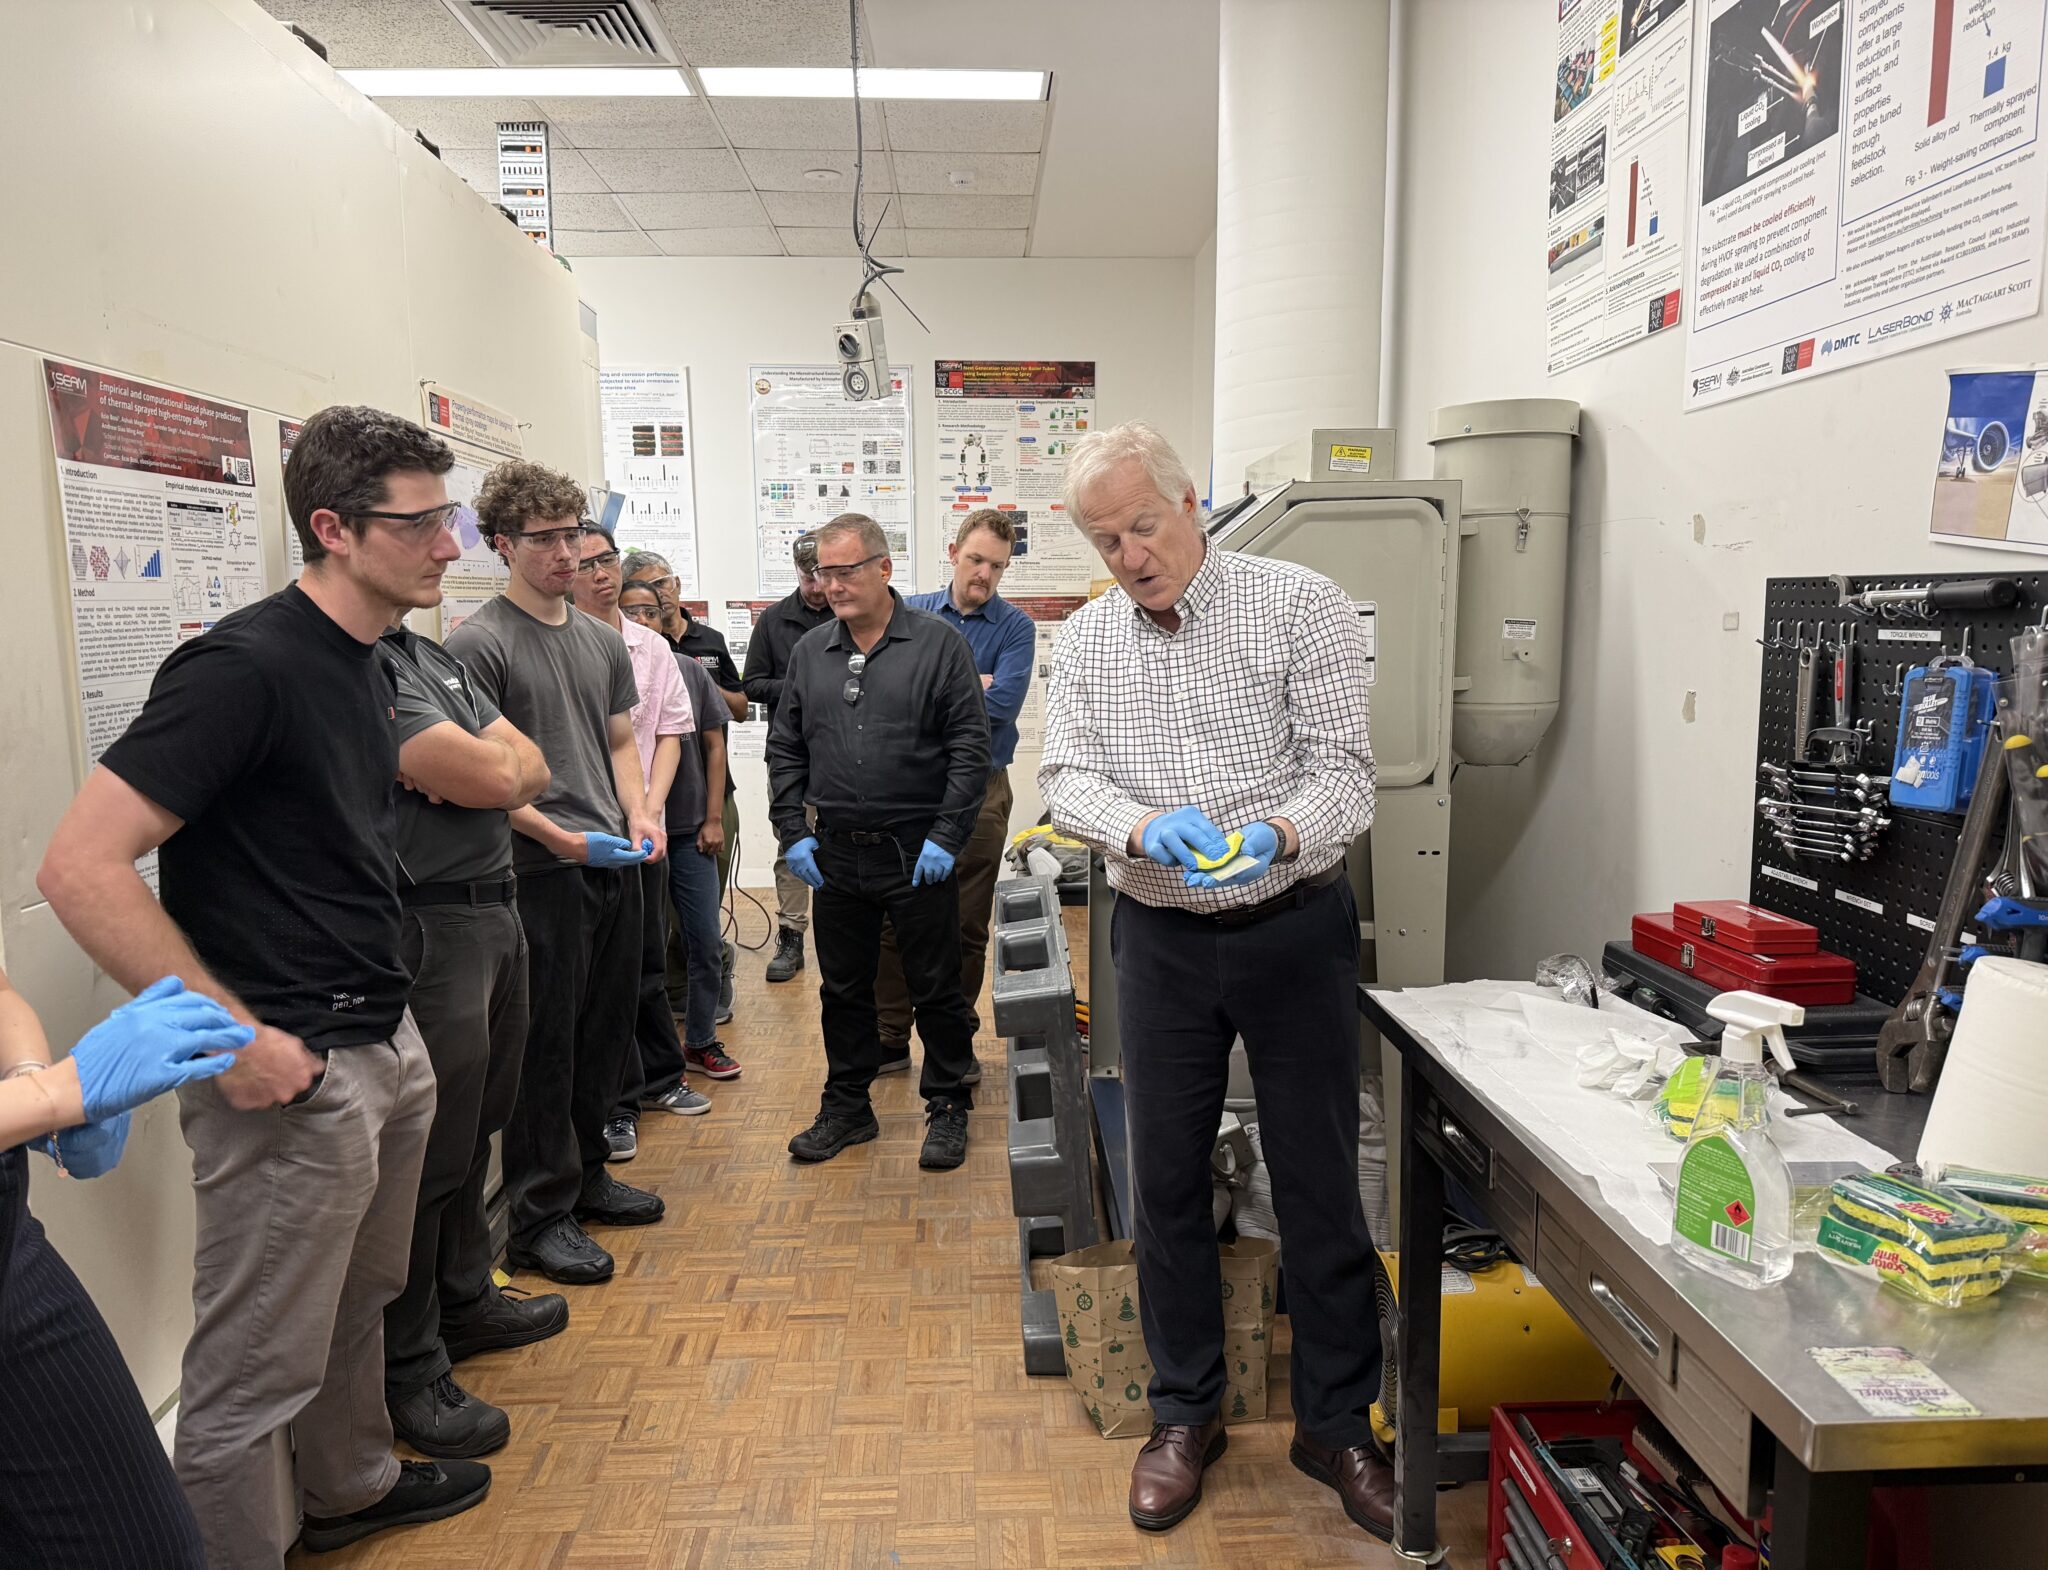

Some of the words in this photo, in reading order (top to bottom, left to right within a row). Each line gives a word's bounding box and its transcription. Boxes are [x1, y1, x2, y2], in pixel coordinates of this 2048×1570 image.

[1811, 7, 1838, 31] Workpiece
[1858, 3, 1905, 38] components
[1859, 0, 1889, 22] sprayed
[1963, 7, 1996, 32] reduction
[1857, 38, 1874, 55] offer
[1875, 35, 1881, 44] a
[1882, 20, 1904, 43] large
[1856, 47, 1891, 72] reduction
[1892, 39, 1900, 53] in
[1987, 48, 1999, 60] 1.4
[2002, 41, 2012, 53] kg
[1855, 67, 1882, 89] weight,
[1883, 56, 1899, 73] and
[1854, 83, 1882, 105] surface
[1969, 100, 2004, 125] Thermally
[2005, 83, 2037, 106] sprayed
[1740, 107, 1754, 122] Liquid
[1852, 123, 1867, 138] can
[1868, 115, 1878, 129] be
[1879, 103, 1902, 124] tuned
[1853, 94, 1892, 125] properties
[1983, 105, 2026, 132] component
[1744, 115, 1761, 130] cooling
[1748, 140, 1776, 162] Compressed
[1776, 136, 1784, 147] air
[1852, 132, 1880, 155] through
[1914, 137, 1930, 153] Solid
[1931, 129, 1947, 147] alloy
[1948, 122, 1960, 137] rod
[1757, 152, 1775, 168] (below)
[1851, 147, 1887, 171] feedstock
[1904, 173, 1917, 186] Fig.
[1918, 170, 1924, 180] 3
[1930, 146, 1978, 174] Weight-saving
[1979, 126, 2024, 151] comparison.
[1743, 187, 1758, 200] cooling
[1757, 182, 1767, 192] and
[1766, 171, 1793, 189] compressed
[1799, 158, 1816, 173] cooling
[1763, 186, 1782, 202] spraying
[1787, 174, 1804, 188] control
[1850, 165, 1885, 187] selection.
[1701, 243, 1712, 256] The
[1711, 234, 1737, 253] substrate
[1737, 226, 1752, 241] must
[1753, 220, 1761, 232] be
[1762, 212, 1783, 229] cooled
[1783, 194, 1816, 219] efficiently
[1700, 256, 1718, 272] during
[1718, 249, 1734, 265] HVOF
[1734, 238, 1758, 258] spraying
[1759, 234, 1766, 244] to
[1766, 225, 1790, 245] prevent
[1790, 206, 1828, 233] component
[1700, 265, 1733, 287] degradation.
[1734, 259, 1744, 272] We
[1744, 253, 1758, 267] used
[1764, 235, 1803, 260] combination
[1803, 229, 1811, 241] of
[1608, 271, 1645, 294] Acknowledgements
[1700, 282, 1732, 304] compressed
[1732, 276, 1740, 288] air
[1741, 271, 1752, 285] and
[1752, 264, 1770, 281] liquid
[1783, 250, 1806, 267] cooling
[1806, 246, 1815, 256] to
[1650, 299, 1664, 312] SWIN
[1699, 297, 1726, 317] effectively
[1726, 290, 1749, 305] manage
[1749, 284, 1764, 298] heat.
[1651, 310, 1662, 320] BUR
[1833, 333, 1861, 352] DMTC
[55, 373, 87, 396] SEAM
[99, 395, 107, 405] of
[107, 397, 134, 409] thermal
[134, 403, 158, 417] sprayed
[158, 408, 193, 426] high-entropy
[193, 417, 208, 429] alloys
[100, 381, 130, 397] Empirical
[130, 390, 142, 400] and
[143, 392, 183, 409] computational
[184, 402, 199, 413] based
[200, 407, 215, 418] phase
[215, 410, 242, 424] predictions
[65, 466, 98, 480] Introduction
[165, 480, 185, 491] Empirical
[185, 484, 200, 493] models
[215, 487, 234, 497] CALPHAD
[234, 489, 252, 499] method
[78, 588, 95, 597] Method
[1890, 631, 1908, 639] TORQUE
[1908, 631, 1928, 639] WRENCH
[86, 689, 104, 699] Results
[1770, 869, 1793, 882] ADJUSTABLE
[1792, 876, 1808, 886] WRENCH
[1846, 895, 1863, 905] WRENCH
[1863, 900, 1872, 908] SET
[1874, 1249, 1900, 1262] Brite
